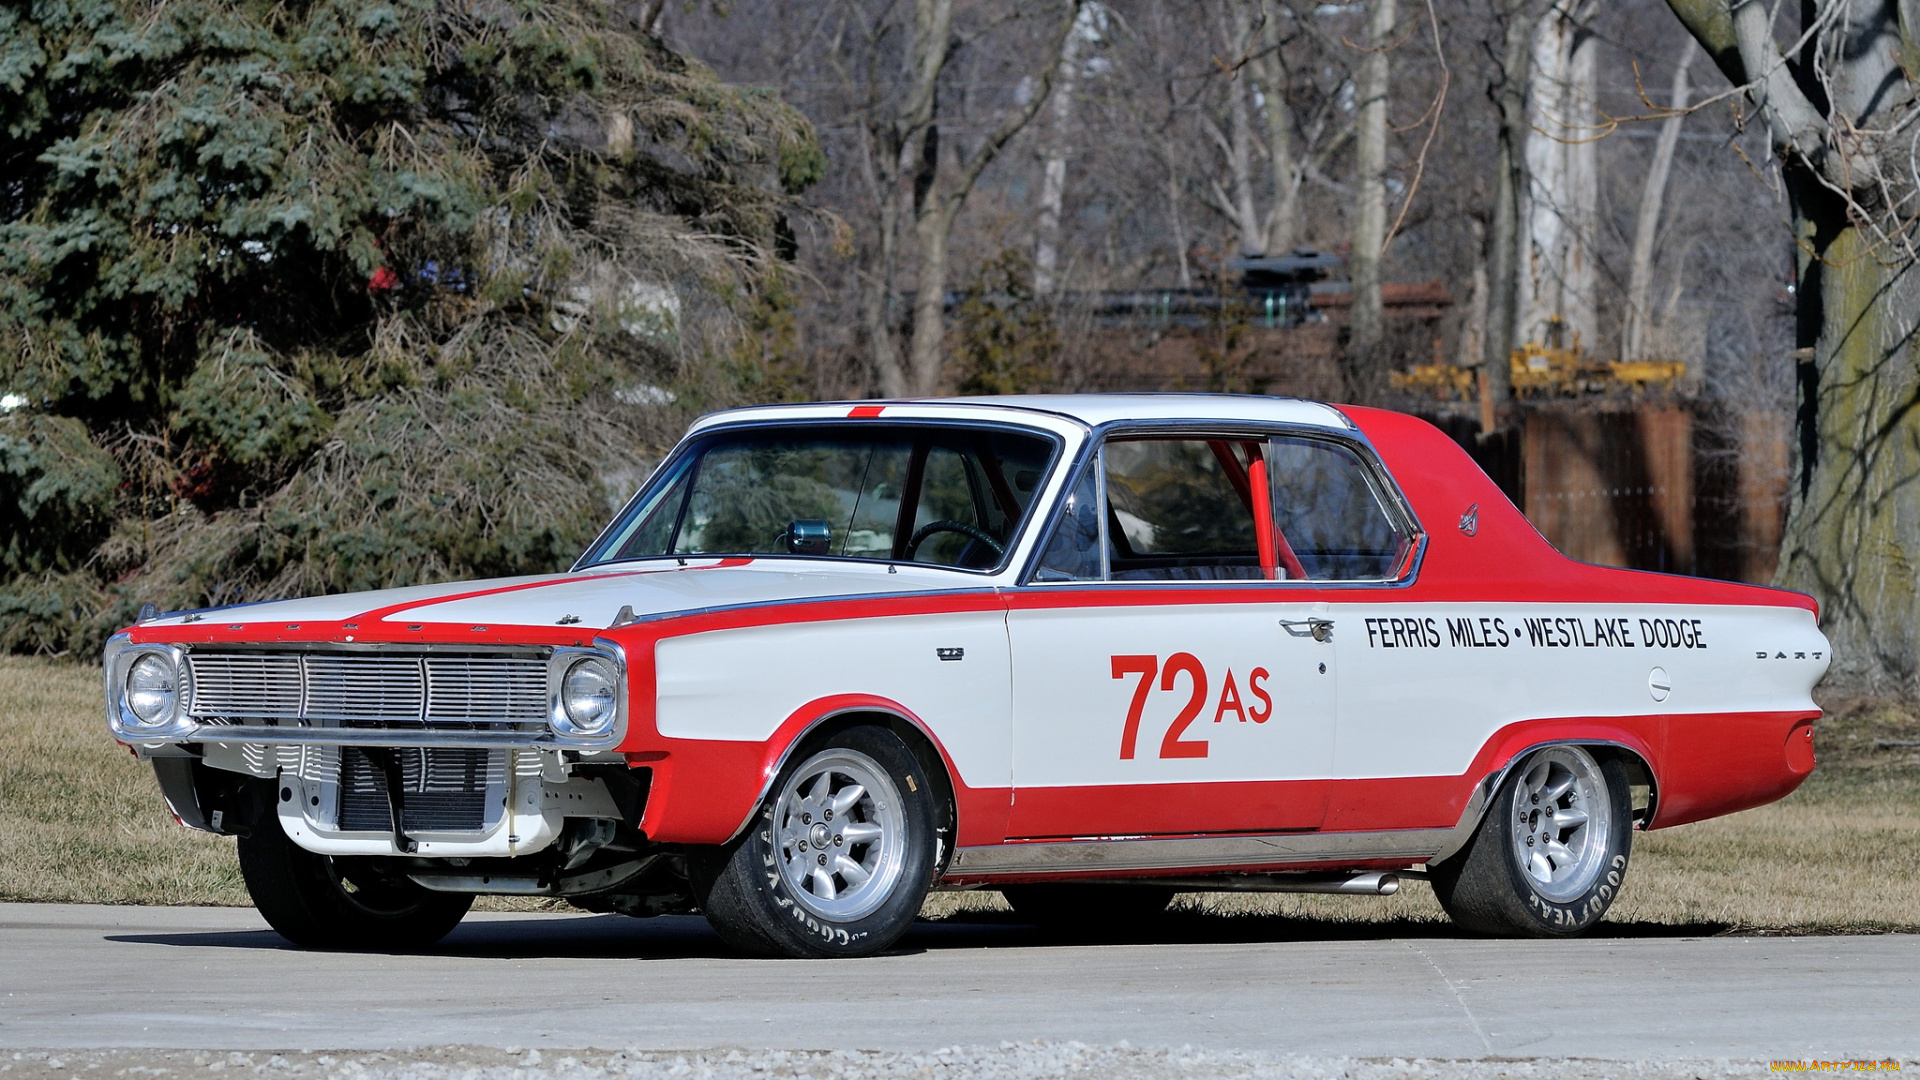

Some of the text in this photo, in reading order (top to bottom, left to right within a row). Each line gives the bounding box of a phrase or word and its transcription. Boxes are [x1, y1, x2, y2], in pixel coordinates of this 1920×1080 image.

[1364, 617, 1708, 649] FERRIS MILES WESTLAKE DODGE
[1755, 651, 1822, 659] DART
[1110, 651, 1272, 760] 72 AS
